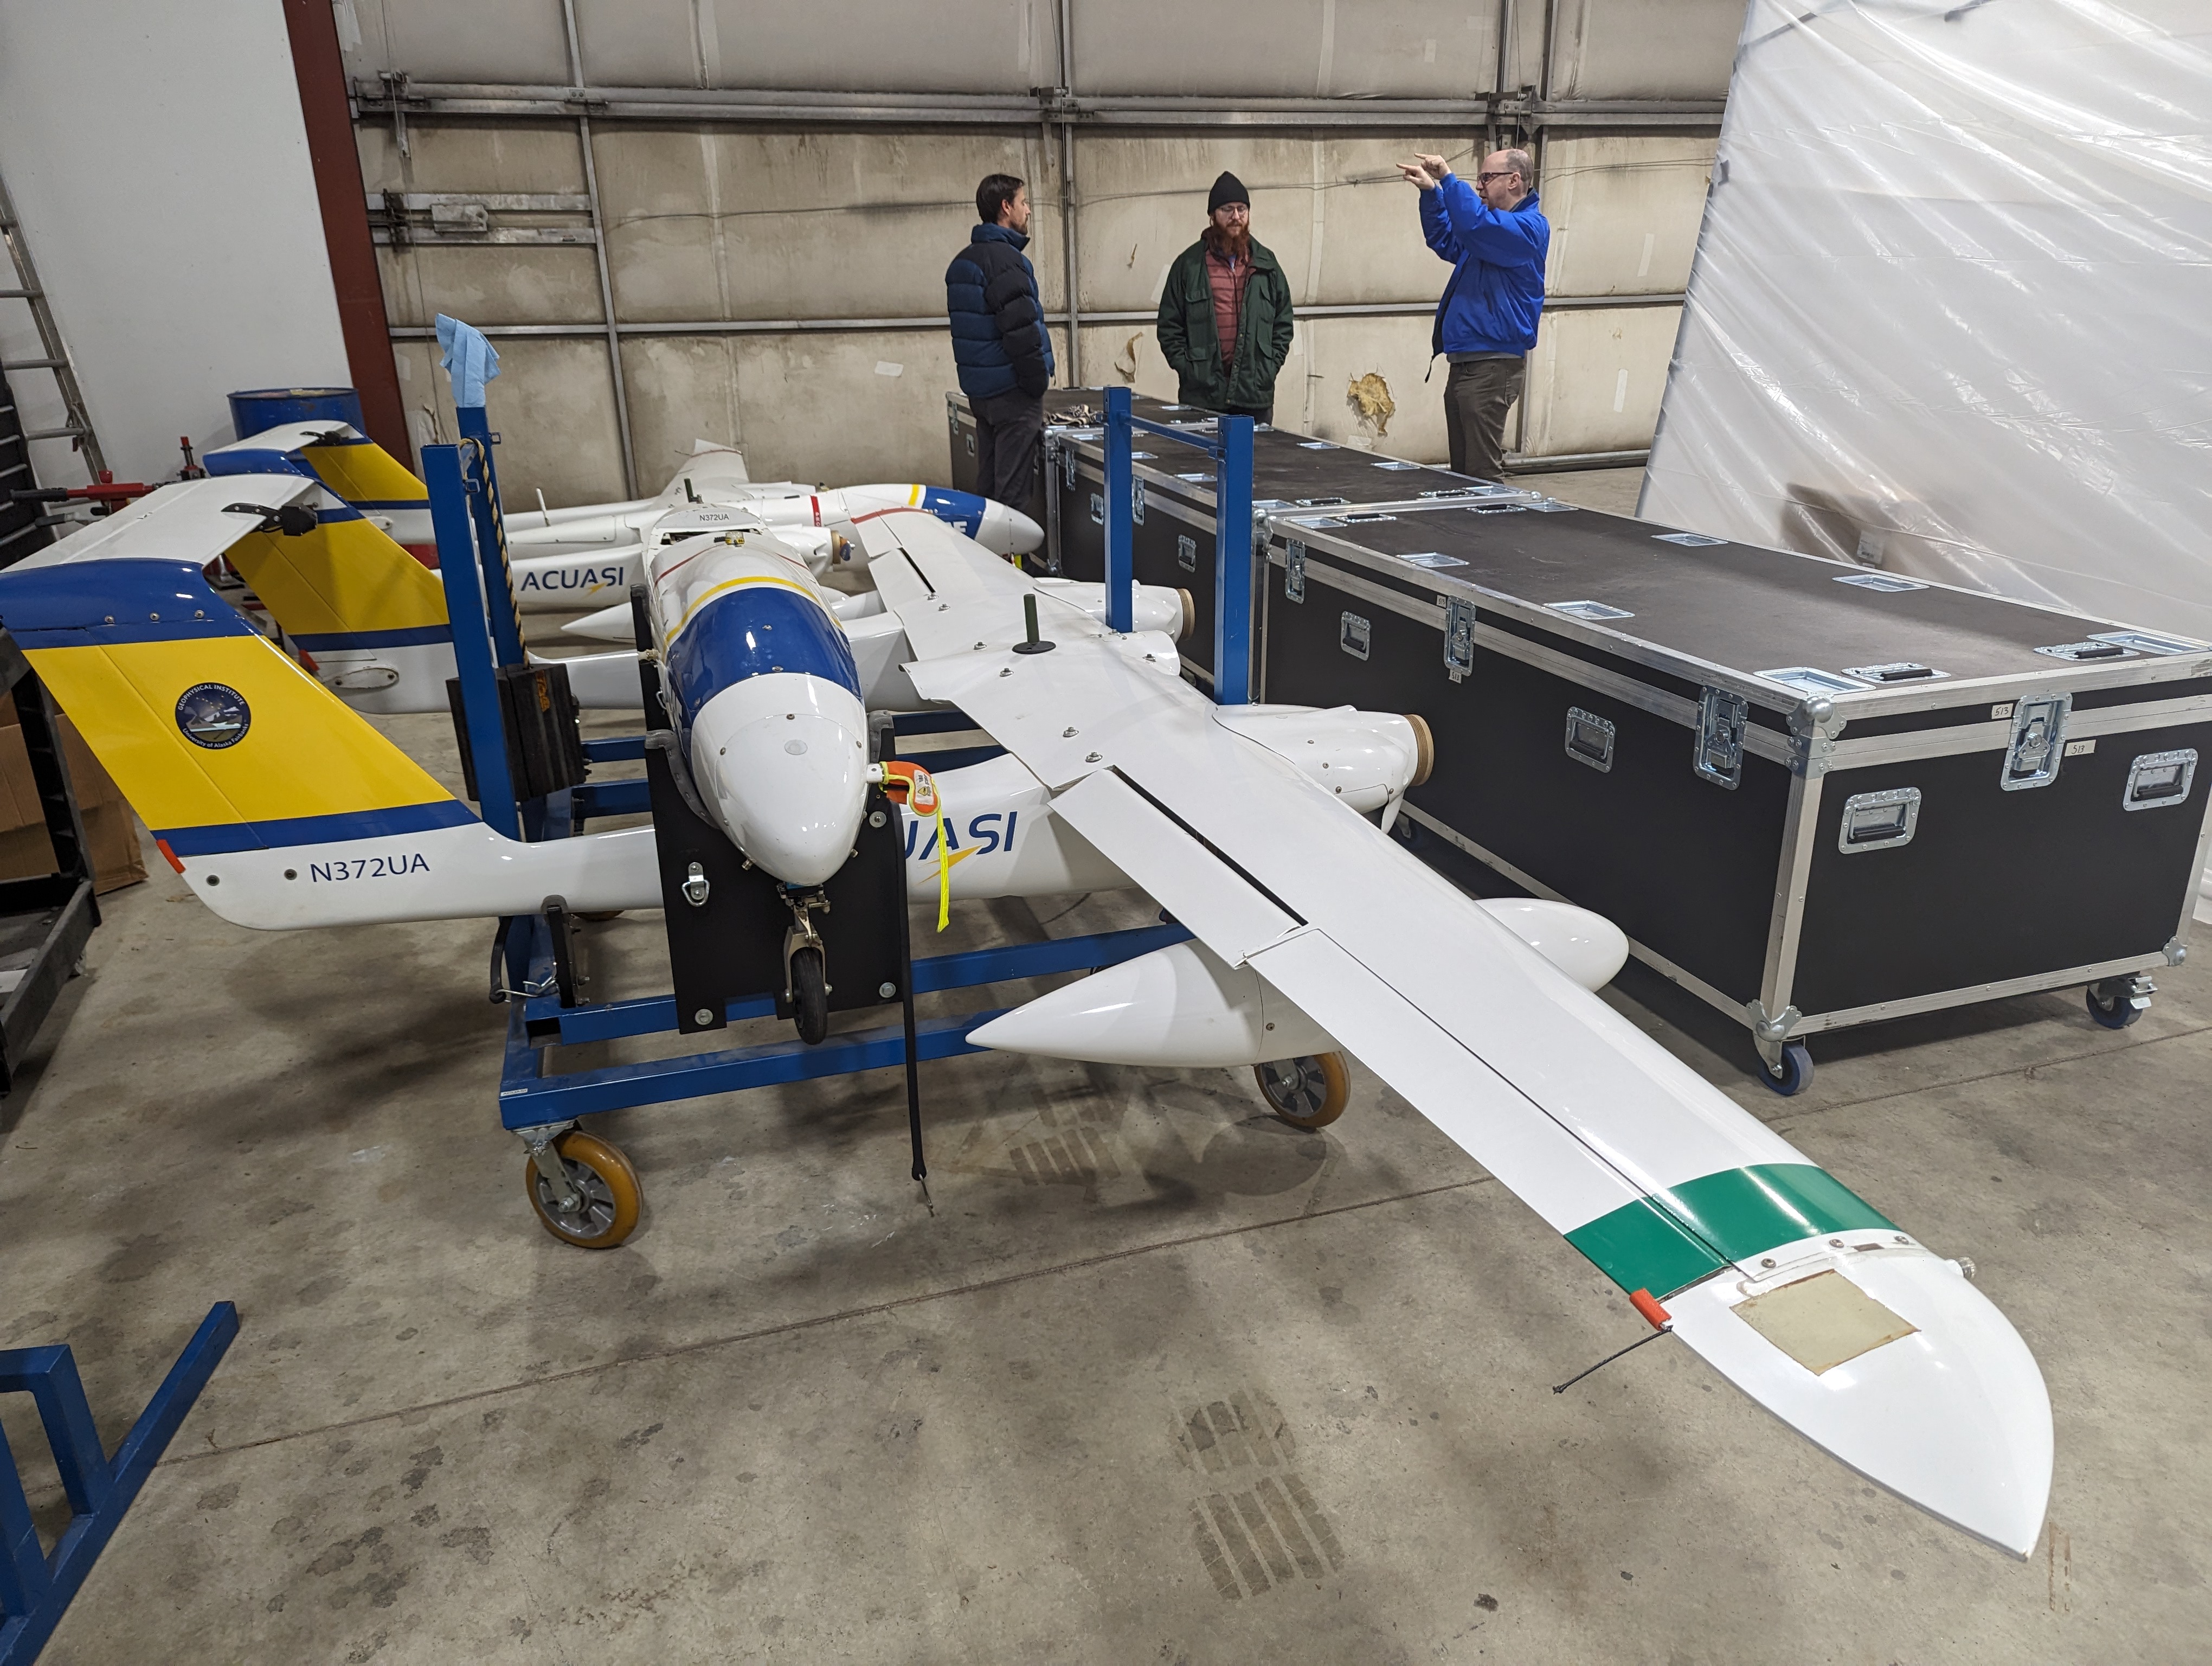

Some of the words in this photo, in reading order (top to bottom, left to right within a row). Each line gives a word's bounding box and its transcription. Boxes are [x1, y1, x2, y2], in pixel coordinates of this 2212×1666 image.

[520, 566, 624, 591] ACUASI
[178, 684, 213, 710] GEOPHYSICAL
[214, 685, 245, 706] INSTITUTE
[1994, 707, 2009, 716] 513
[182, 728, 206, 747] University
[231, 723, 249, 743] Fairbanks
[2071, 745, 2085, 754] 513
[310, 853, 430, 882] N372UA
